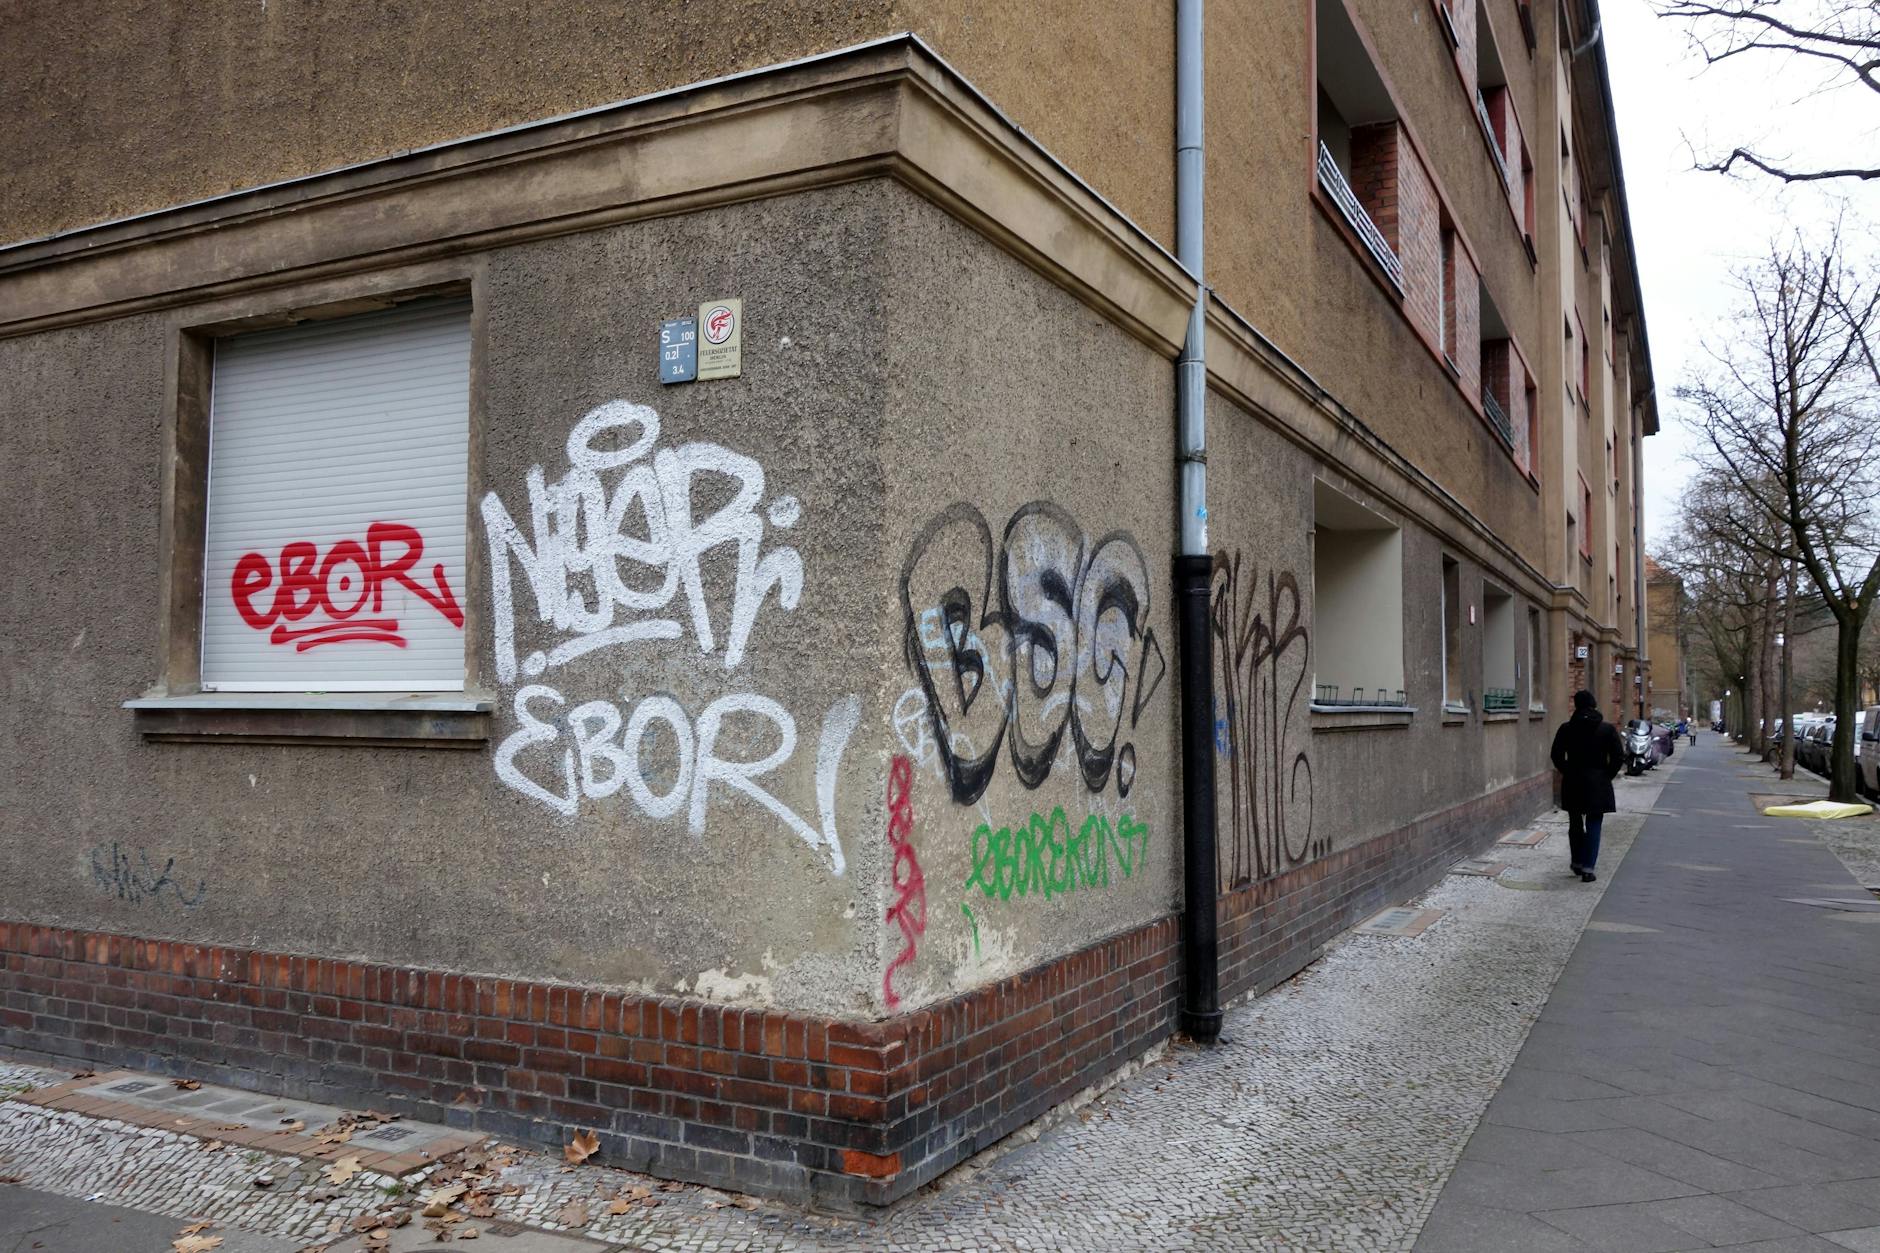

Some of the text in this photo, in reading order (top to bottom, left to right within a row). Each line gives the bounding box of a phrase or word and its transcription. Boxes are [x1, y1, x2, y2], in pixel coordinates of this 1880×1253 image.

[661, 330, 694, 343] S 100
[665, 351, 677, 361] 0.2
[672, 364, 684, 374] 3.4
